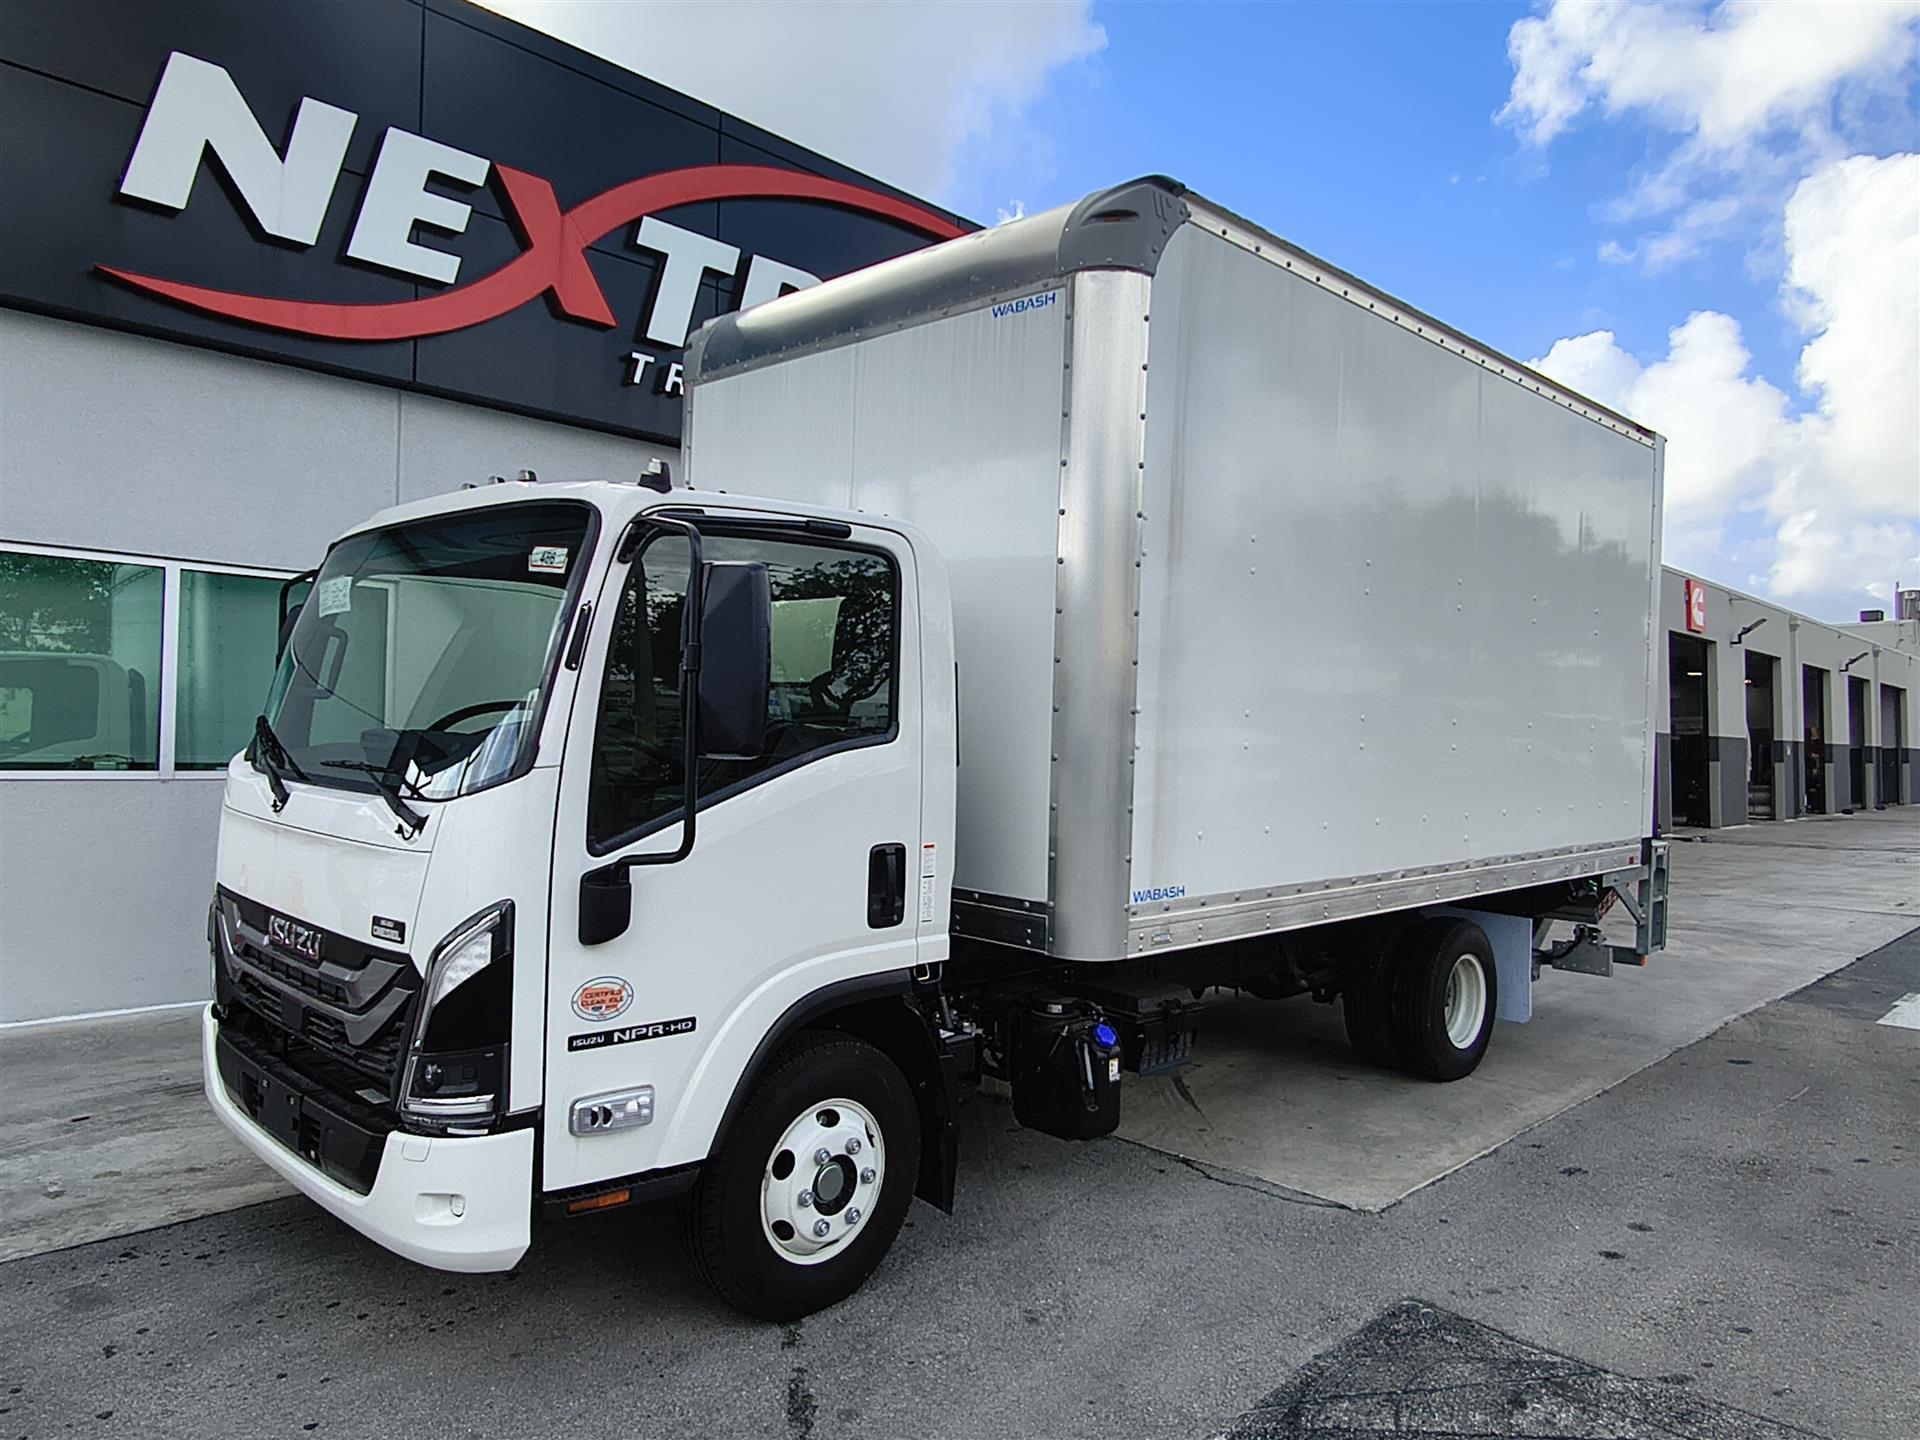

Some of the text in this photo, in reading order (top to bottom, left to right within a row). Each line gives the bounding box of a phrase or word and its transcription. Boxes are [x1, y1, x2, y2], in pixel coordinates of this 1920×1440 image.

[992, 292, 1056, 318] WABASH
[1133, 885, 1185, 902] WABASH
[269, 915, 322, 960] ISUZU
[572, 1035, 605, 1047] ISUZU
